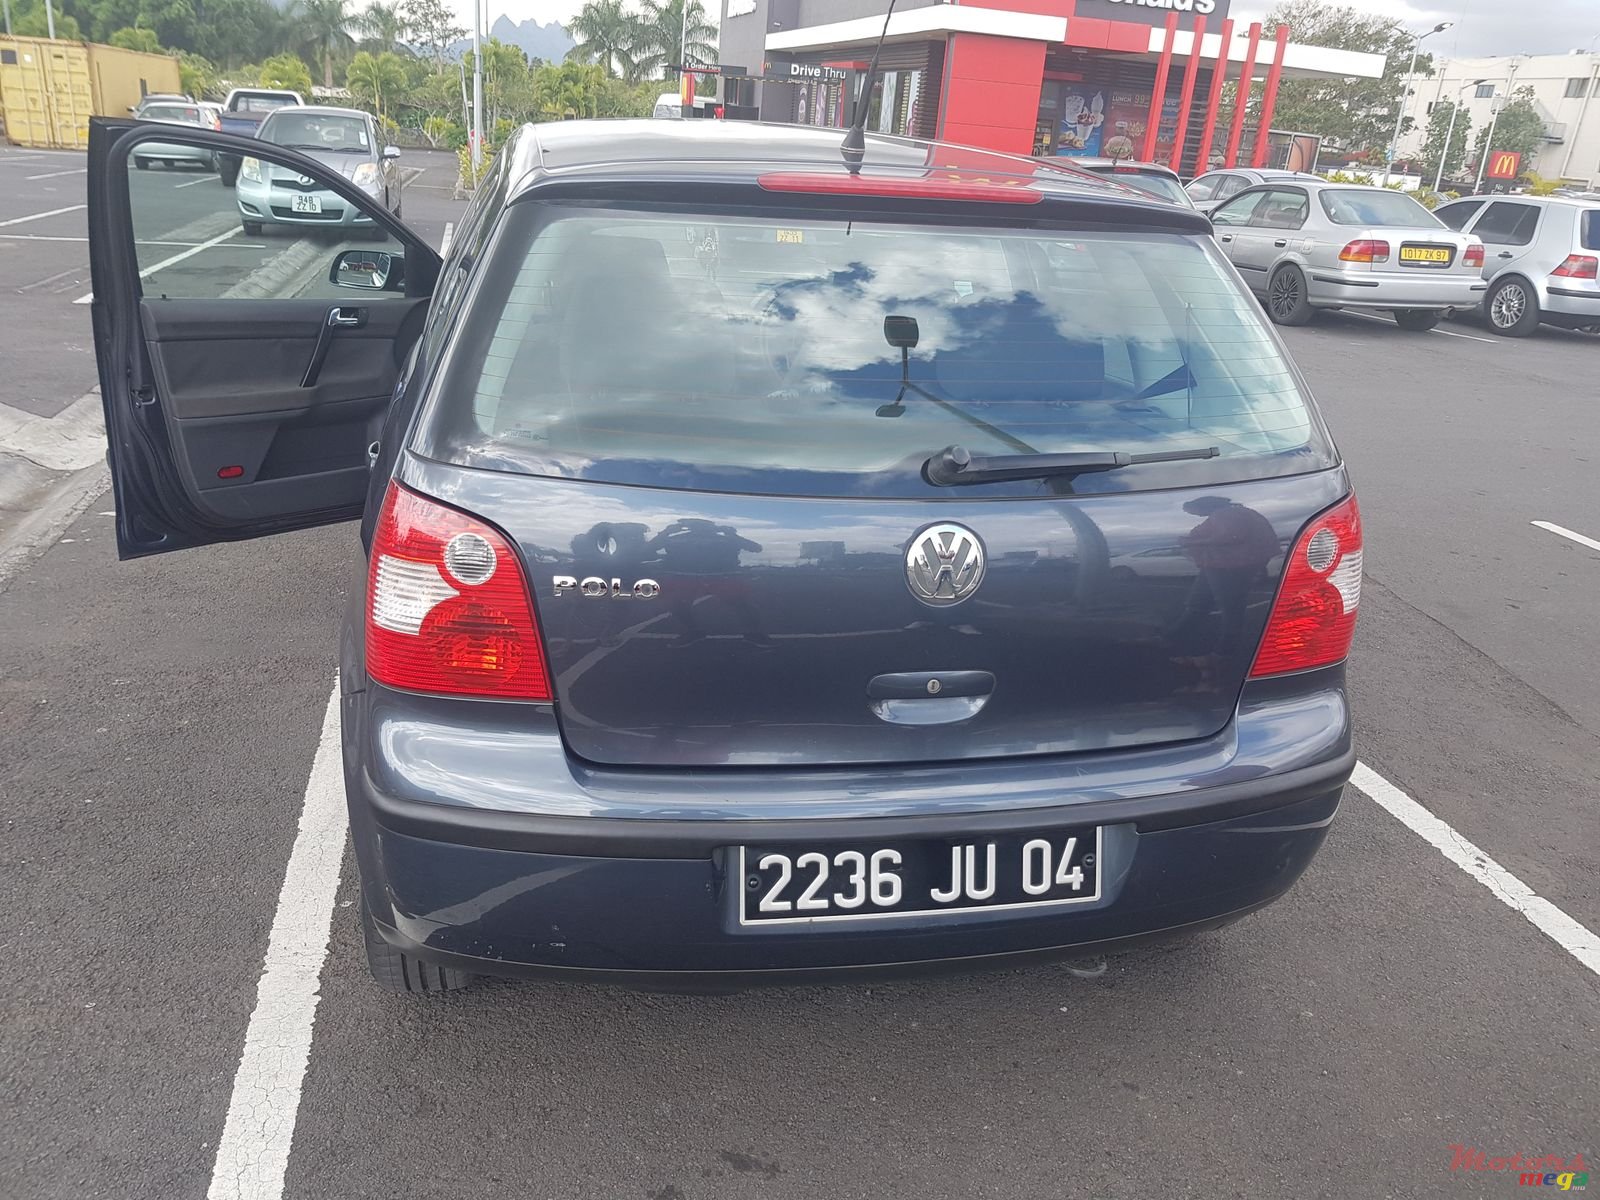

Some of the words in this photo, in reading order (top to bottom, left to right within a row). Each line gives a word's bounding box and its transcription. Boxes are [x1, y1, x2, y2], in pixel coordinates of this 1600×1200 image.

[690, 62, 708, 70] Order
[790, 63, 821, 77] Drive
[823, 66, 847, 79] Thru
[1403, 248, 1423, 259] 1017
[1424, 250, 1434, 260] ZK
[1436, 250, 1447, 260] 97
[552, 575, 661, 599] POLO
[758, 848, 903, 912] 2236
[929, 843, 997, 903] JU
[1021, 837, 1084, 896] 04
